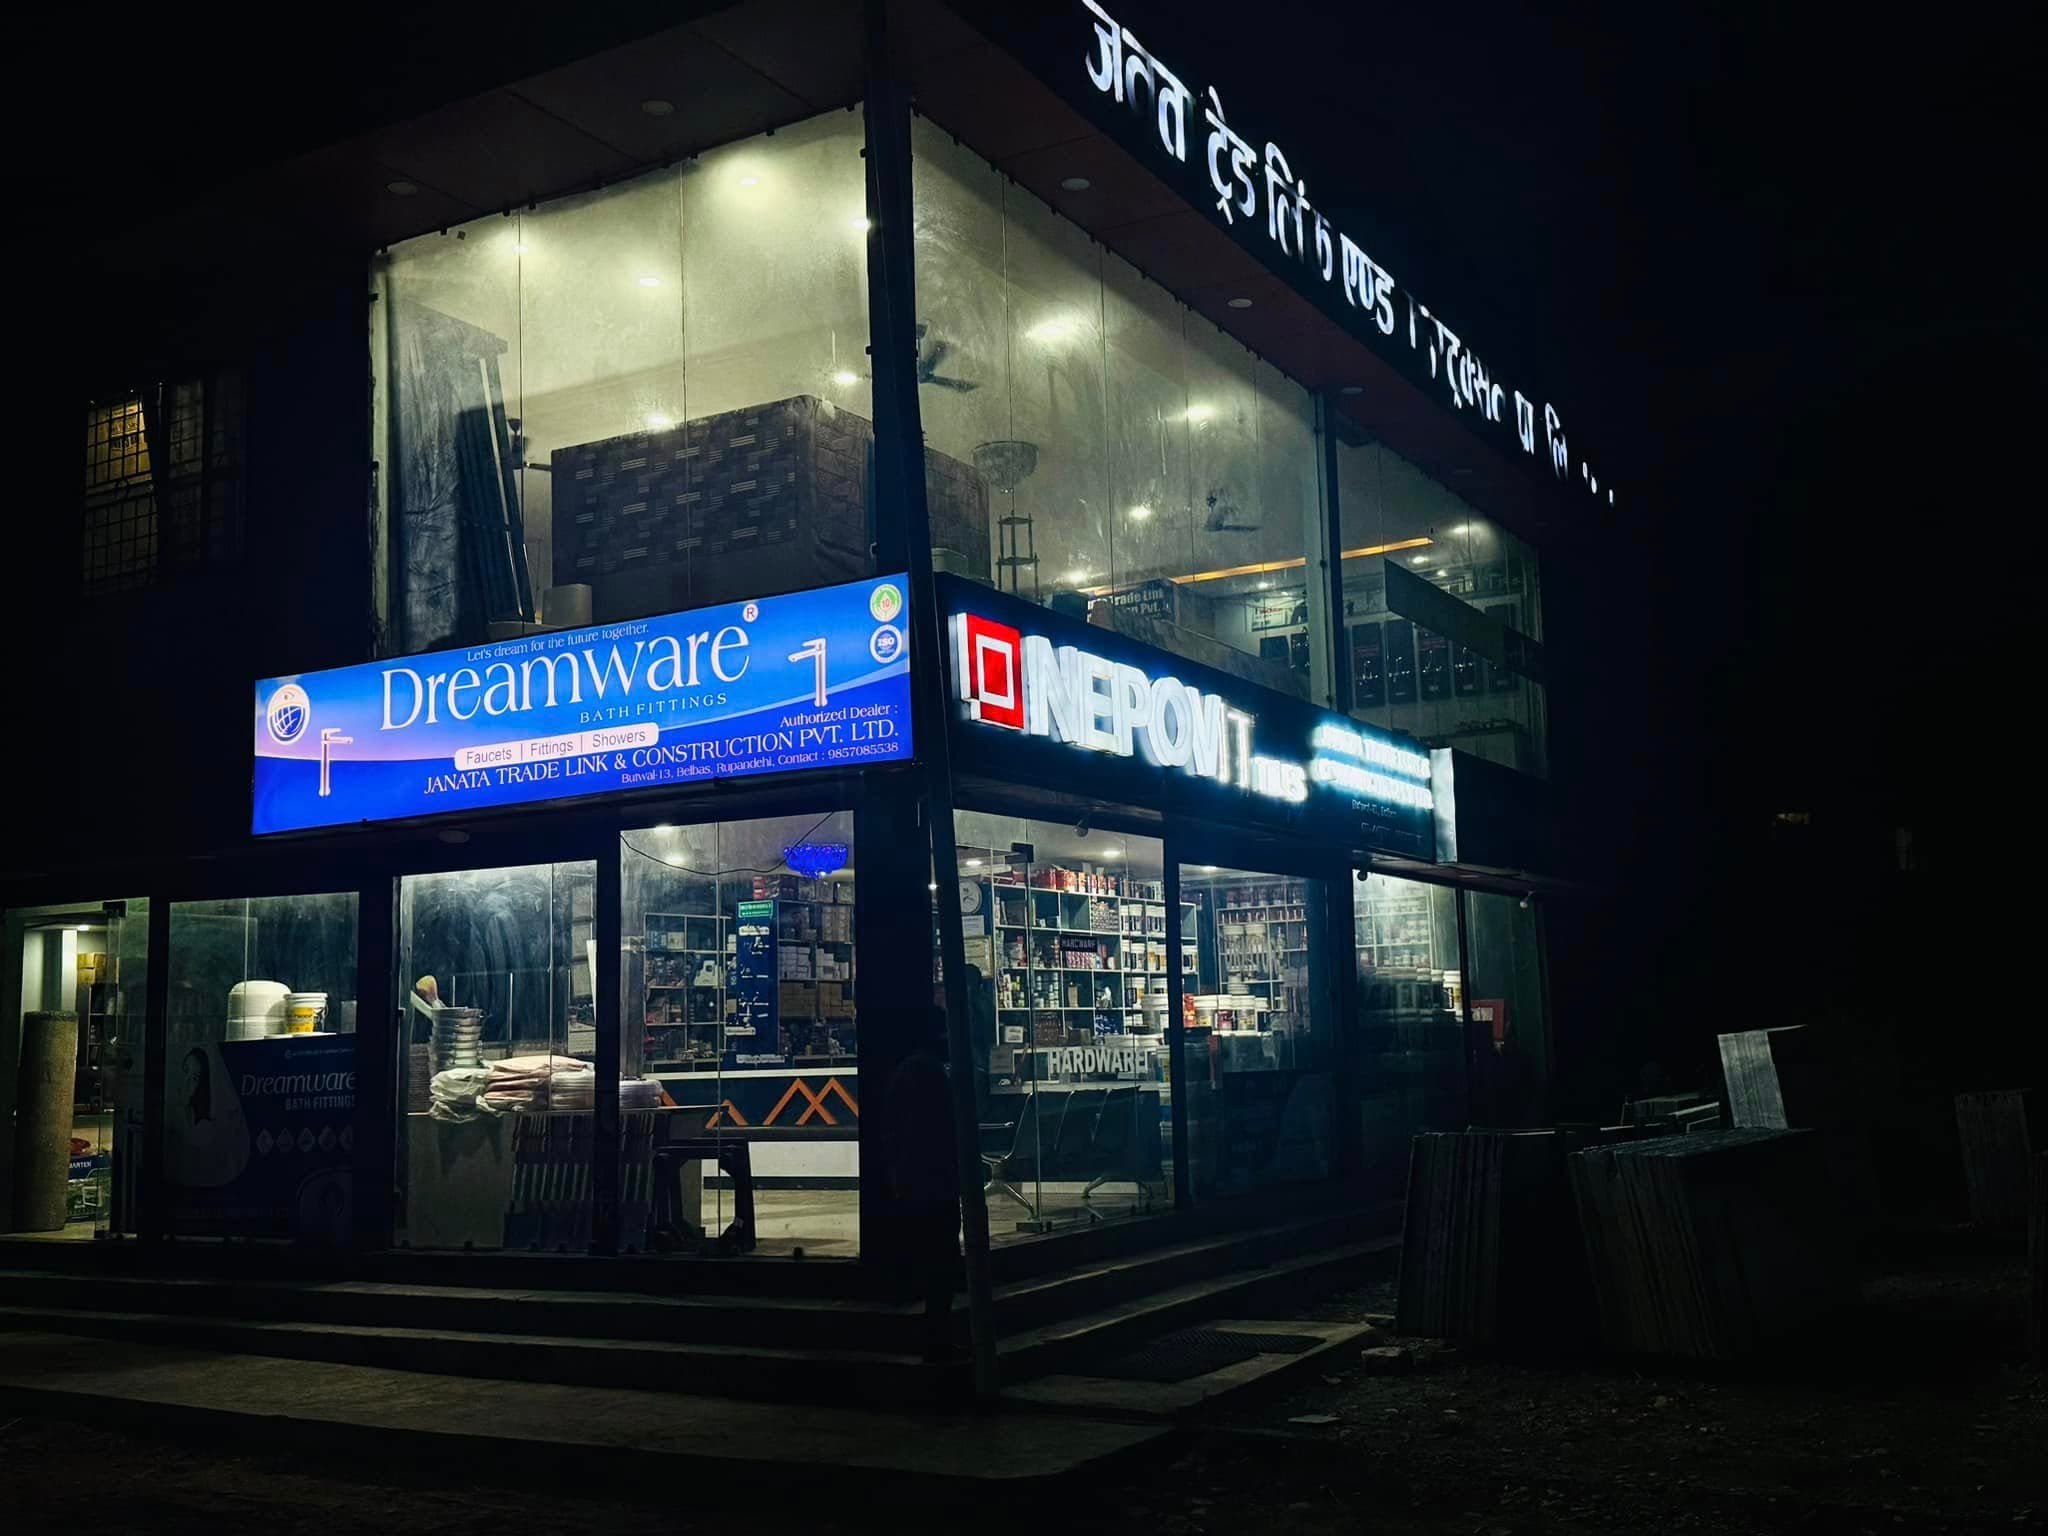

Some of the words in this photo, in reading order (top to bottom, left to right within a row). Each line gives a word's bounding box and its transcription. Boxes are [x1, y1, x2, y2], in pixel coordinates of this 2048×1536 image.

[467, 648, 492, 662] Let's
[494, 643, 528, 657] dream
[531, 638, 545, 652] for
[548, 636, 565, 649] the
[567, 631, 599, 645] future
[602, 622, 649, 641] together.
[380, 625, 750, 731] Dreamware
[580, 704, 629, 723] BATH
[637, 692, 727, 715] FITTINGS
[780, 707, 847, 728] Authorized
[850, 704, 890, 719] Dealer
[531, 738, 574, 757] Fittings
[592, 729, 646, 748] Showers
[424, 770, 491, 794] JANATA
[496, 762, 560, 785] TRADE
[566, 754, 608, 777] LINK
[614, 753, 627, 770] &
[633, 730, 793, 768] CONSTRUCTION
[800, 725, 844, 747] PVT.
[852, 719, 899, 741] LTD.
[466, 747, 512, 765] Faucets
[778, 752, 818, 766] Contact
[828, 742, 899, 760] 9857085538
[1049, 1047, 1149, 1073] HARDWARE
[241, 1072, 357, 1096] Dreamware
